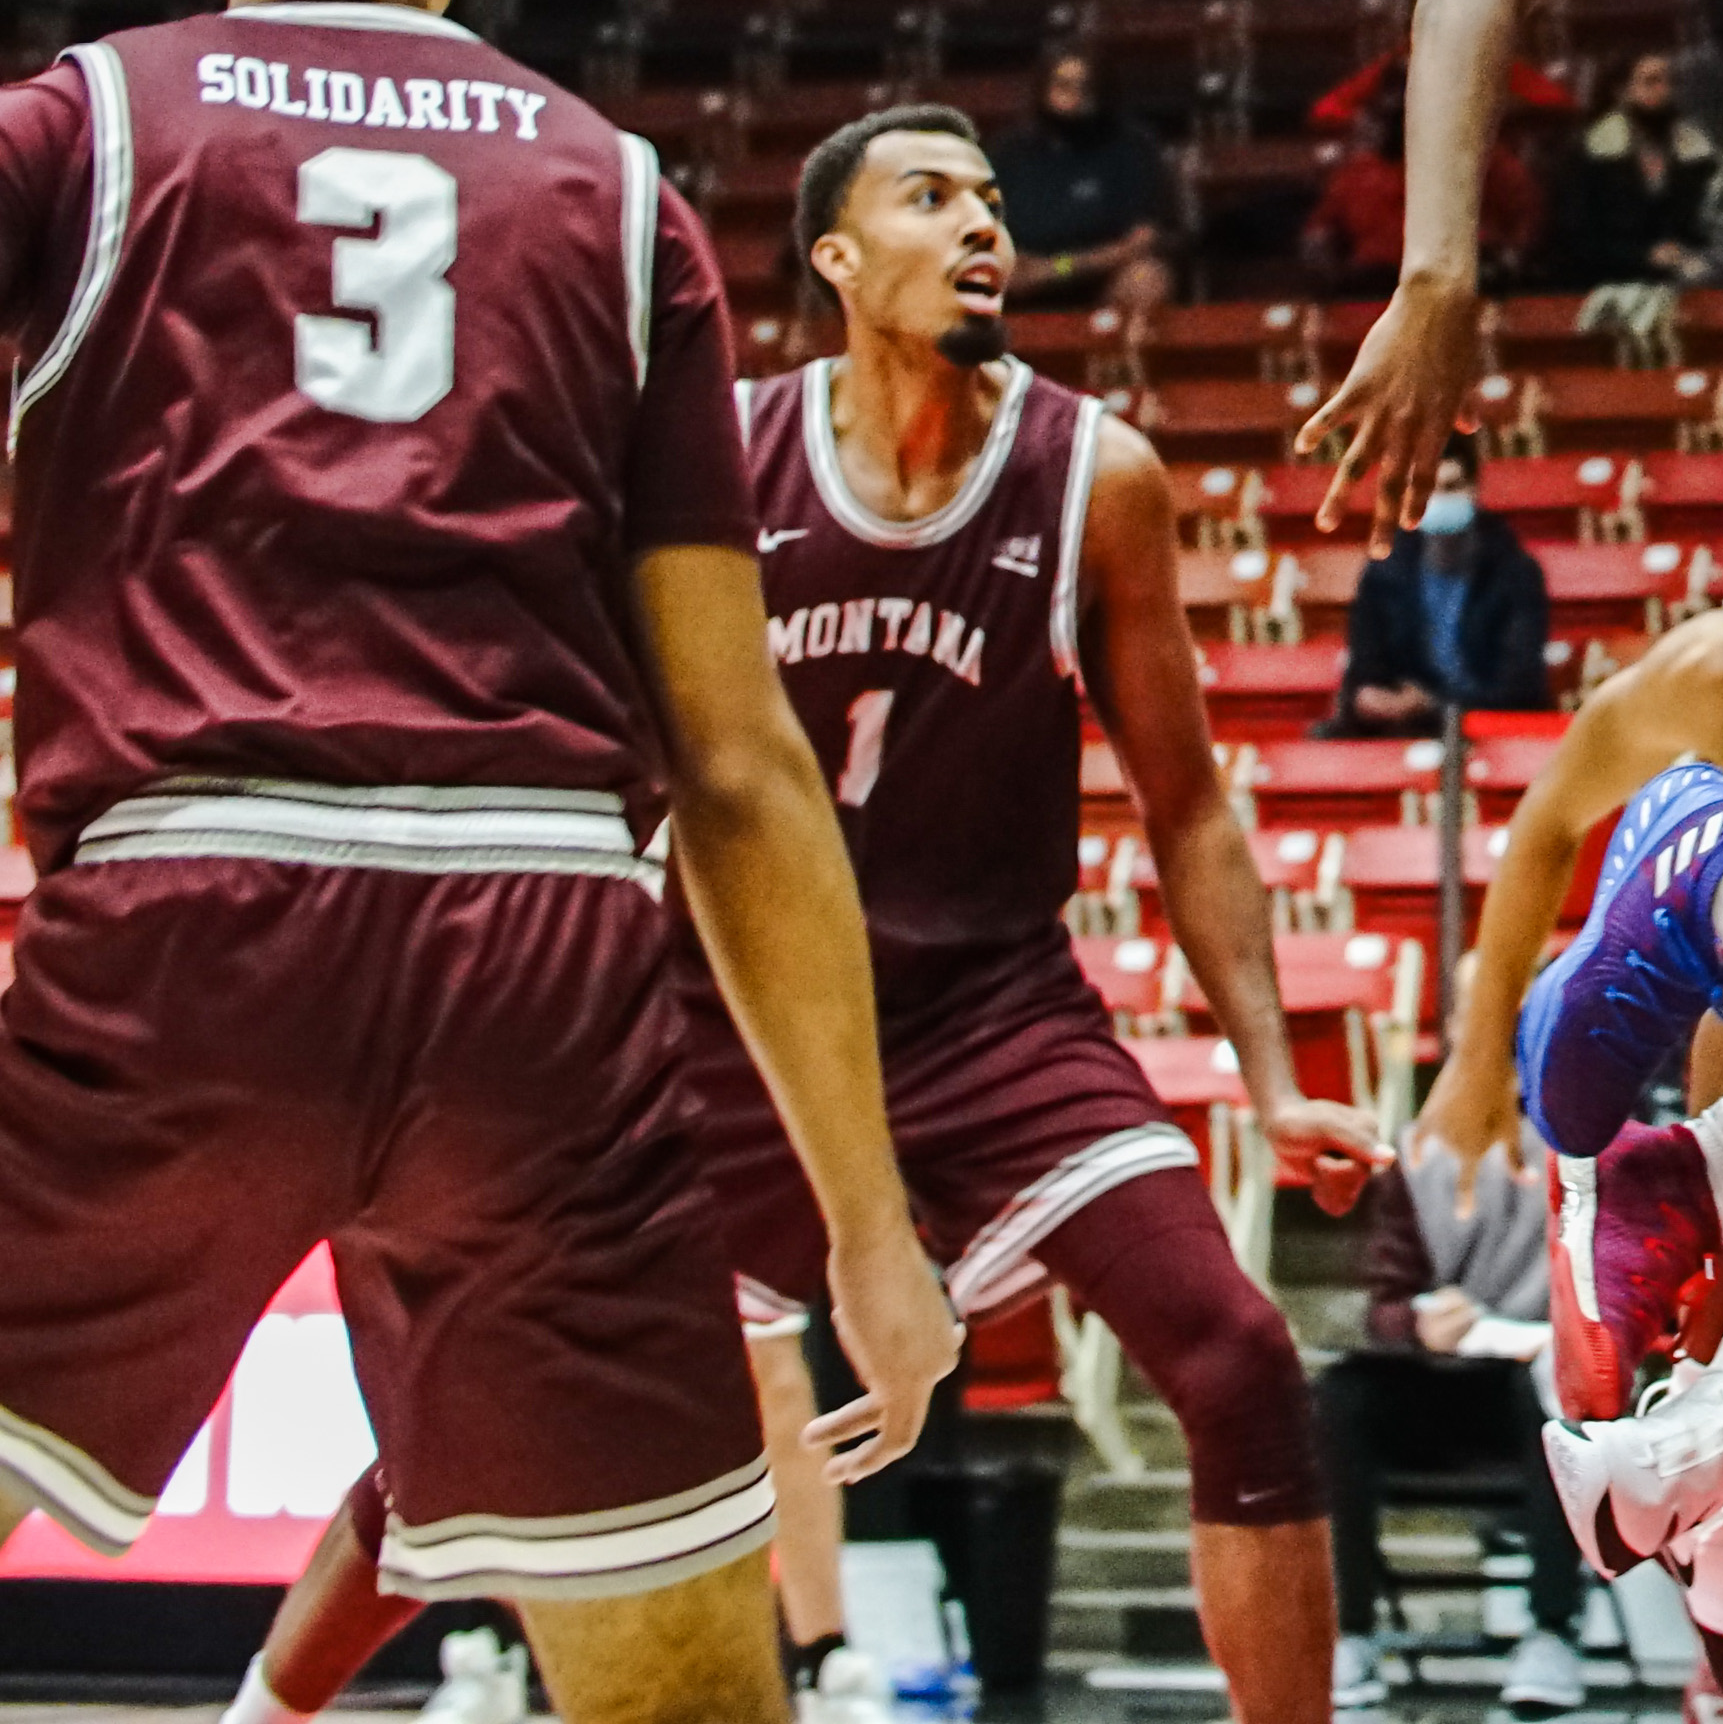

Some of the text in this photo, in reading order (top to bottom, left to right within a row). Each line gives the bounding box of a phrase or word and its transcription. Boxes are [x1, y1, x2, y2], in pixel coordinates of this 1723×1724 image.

[198, 53, 546, 141] SOLIDARITY
[294, 146, 459, 423] 3
[767, 597, 985, 687] MONTANA
[838, 689, 895, 807] 1
